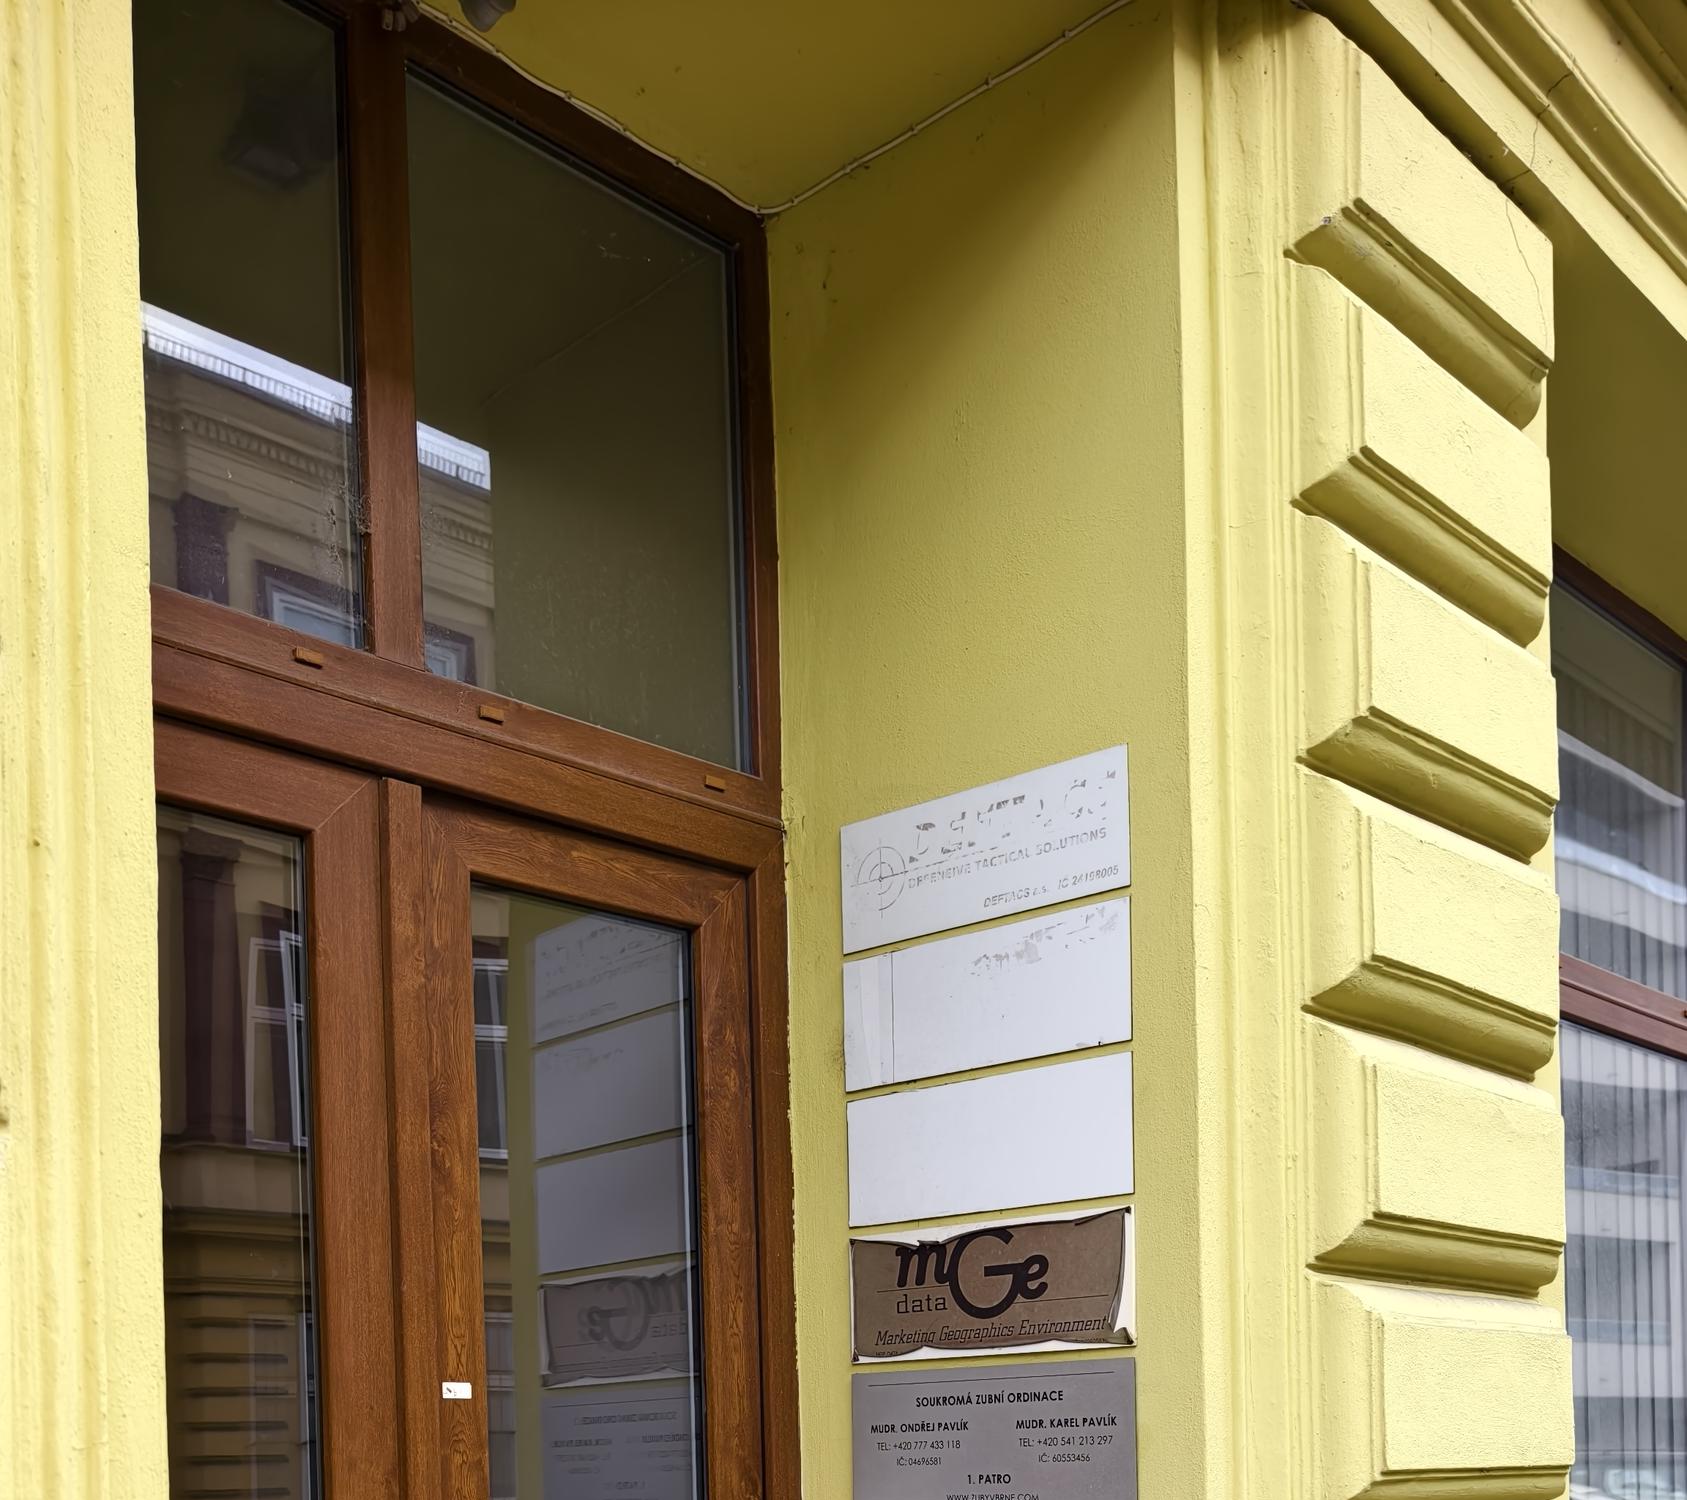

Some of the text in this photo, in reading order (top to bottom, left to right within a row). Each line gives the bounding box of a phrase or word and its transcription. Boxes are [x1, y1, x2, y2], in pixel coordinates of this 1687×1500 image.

[896, 1294, 947, 1314] data
[875, 1316, 1108, 1346] Marketing Geographics Environment
[916, 1390, 1064, 1408] SOUKROMÁ ZUBNÍ ORDINACE
[870, 1418, 969, 1434] MUDR. ONDŘEJ PAVLÍK
[1015, 1413, 1117, 1430] MUDR. KAREL PAVLÍK
[893, 1441, 912, 1451] +420
[913, 1440, 928, 1450] 777
[930, 1440, 944, 1450] 433
[947, 1439, 961, 1449] 118
[1037, 1436, 1059, 1447] +420
[1060, 1436, 1076, 1446] 541
[1079, 1436, 1095, 1446] 213
[1097, 1435, 1113, 1445] 297
[1052, 1453, 1091, 1463] 60553456
[967, 1473, 1012, 1485] 1. PATRO
